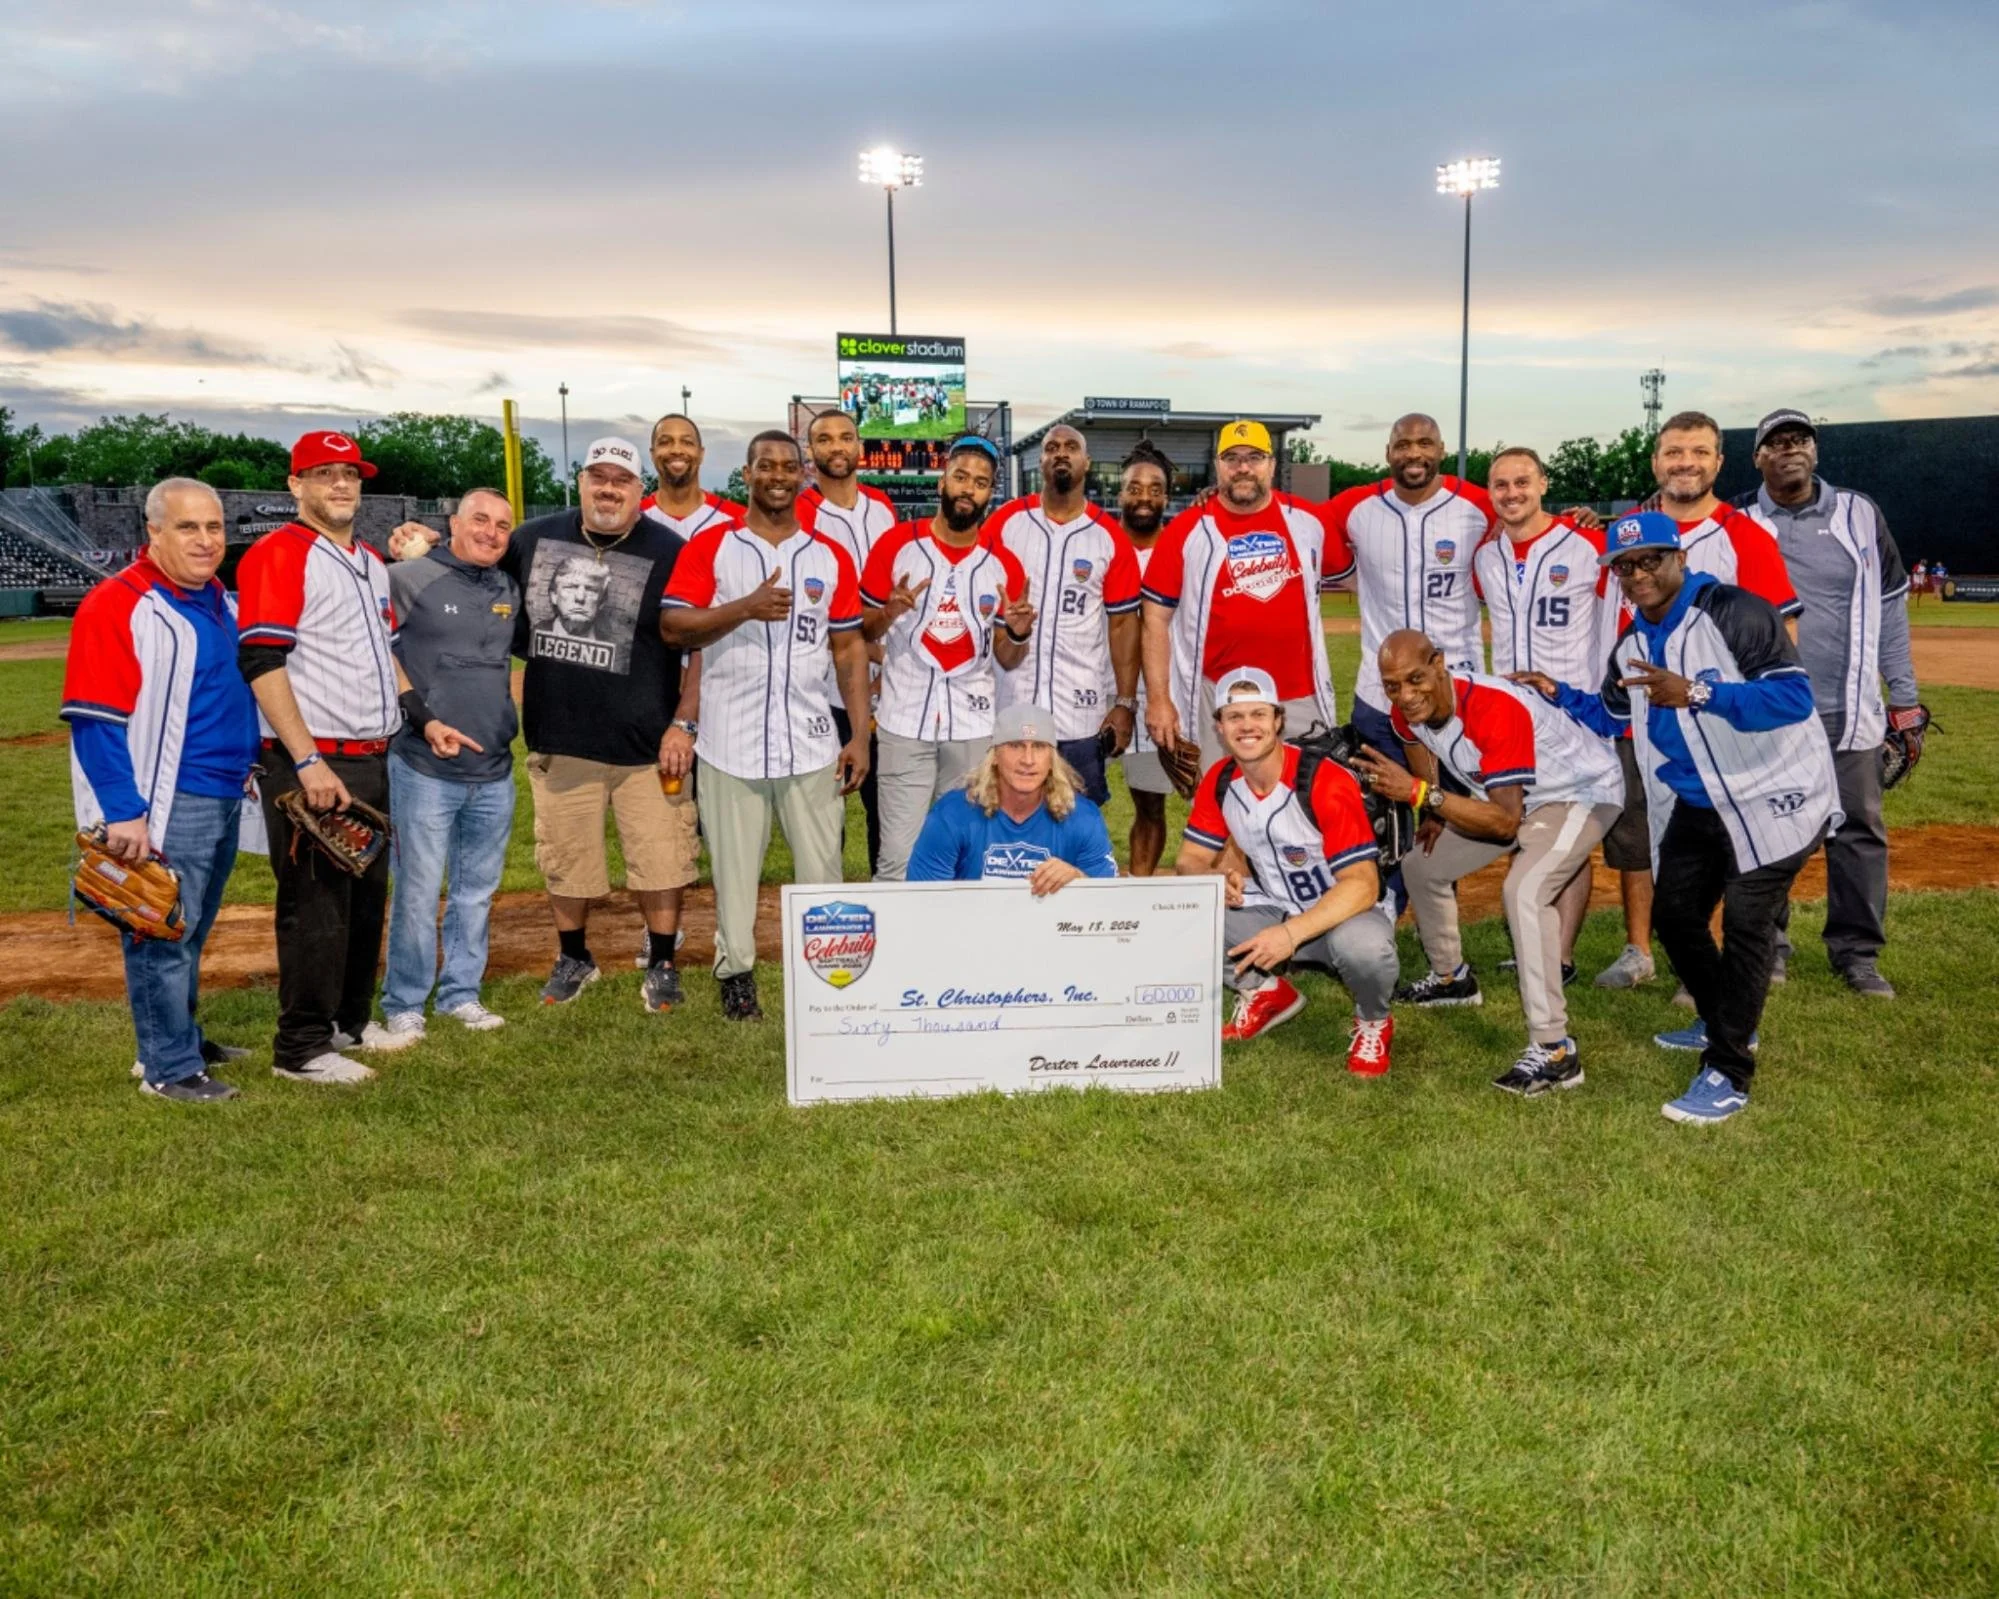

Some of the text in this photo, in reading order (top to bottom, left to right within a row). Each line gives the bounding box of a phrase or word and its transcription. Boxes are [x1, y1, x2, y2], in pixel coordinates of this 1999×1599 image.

[1427, 572, 1456, 599] 27
[1063, 589, 1087, 616] 24
[1536, 597, 1570, 627] 15
[796, 614, 817, 645] 53
[537, 636, 610, 667] LEGEND
[1288, 865, 1329, 902] 81
[1057, 922, 1083, 933] May
[1110, 920, 1140, 931] 2024
[804, 932, 876, 961] Celebrity
[900, 990, 929, 1007] St.
[1064, 985, 1098, 1002] Inc.
[1029, 1055, 1079, 1072] Dexter
[1085, 1054, 1161, 1070] Lawrence
